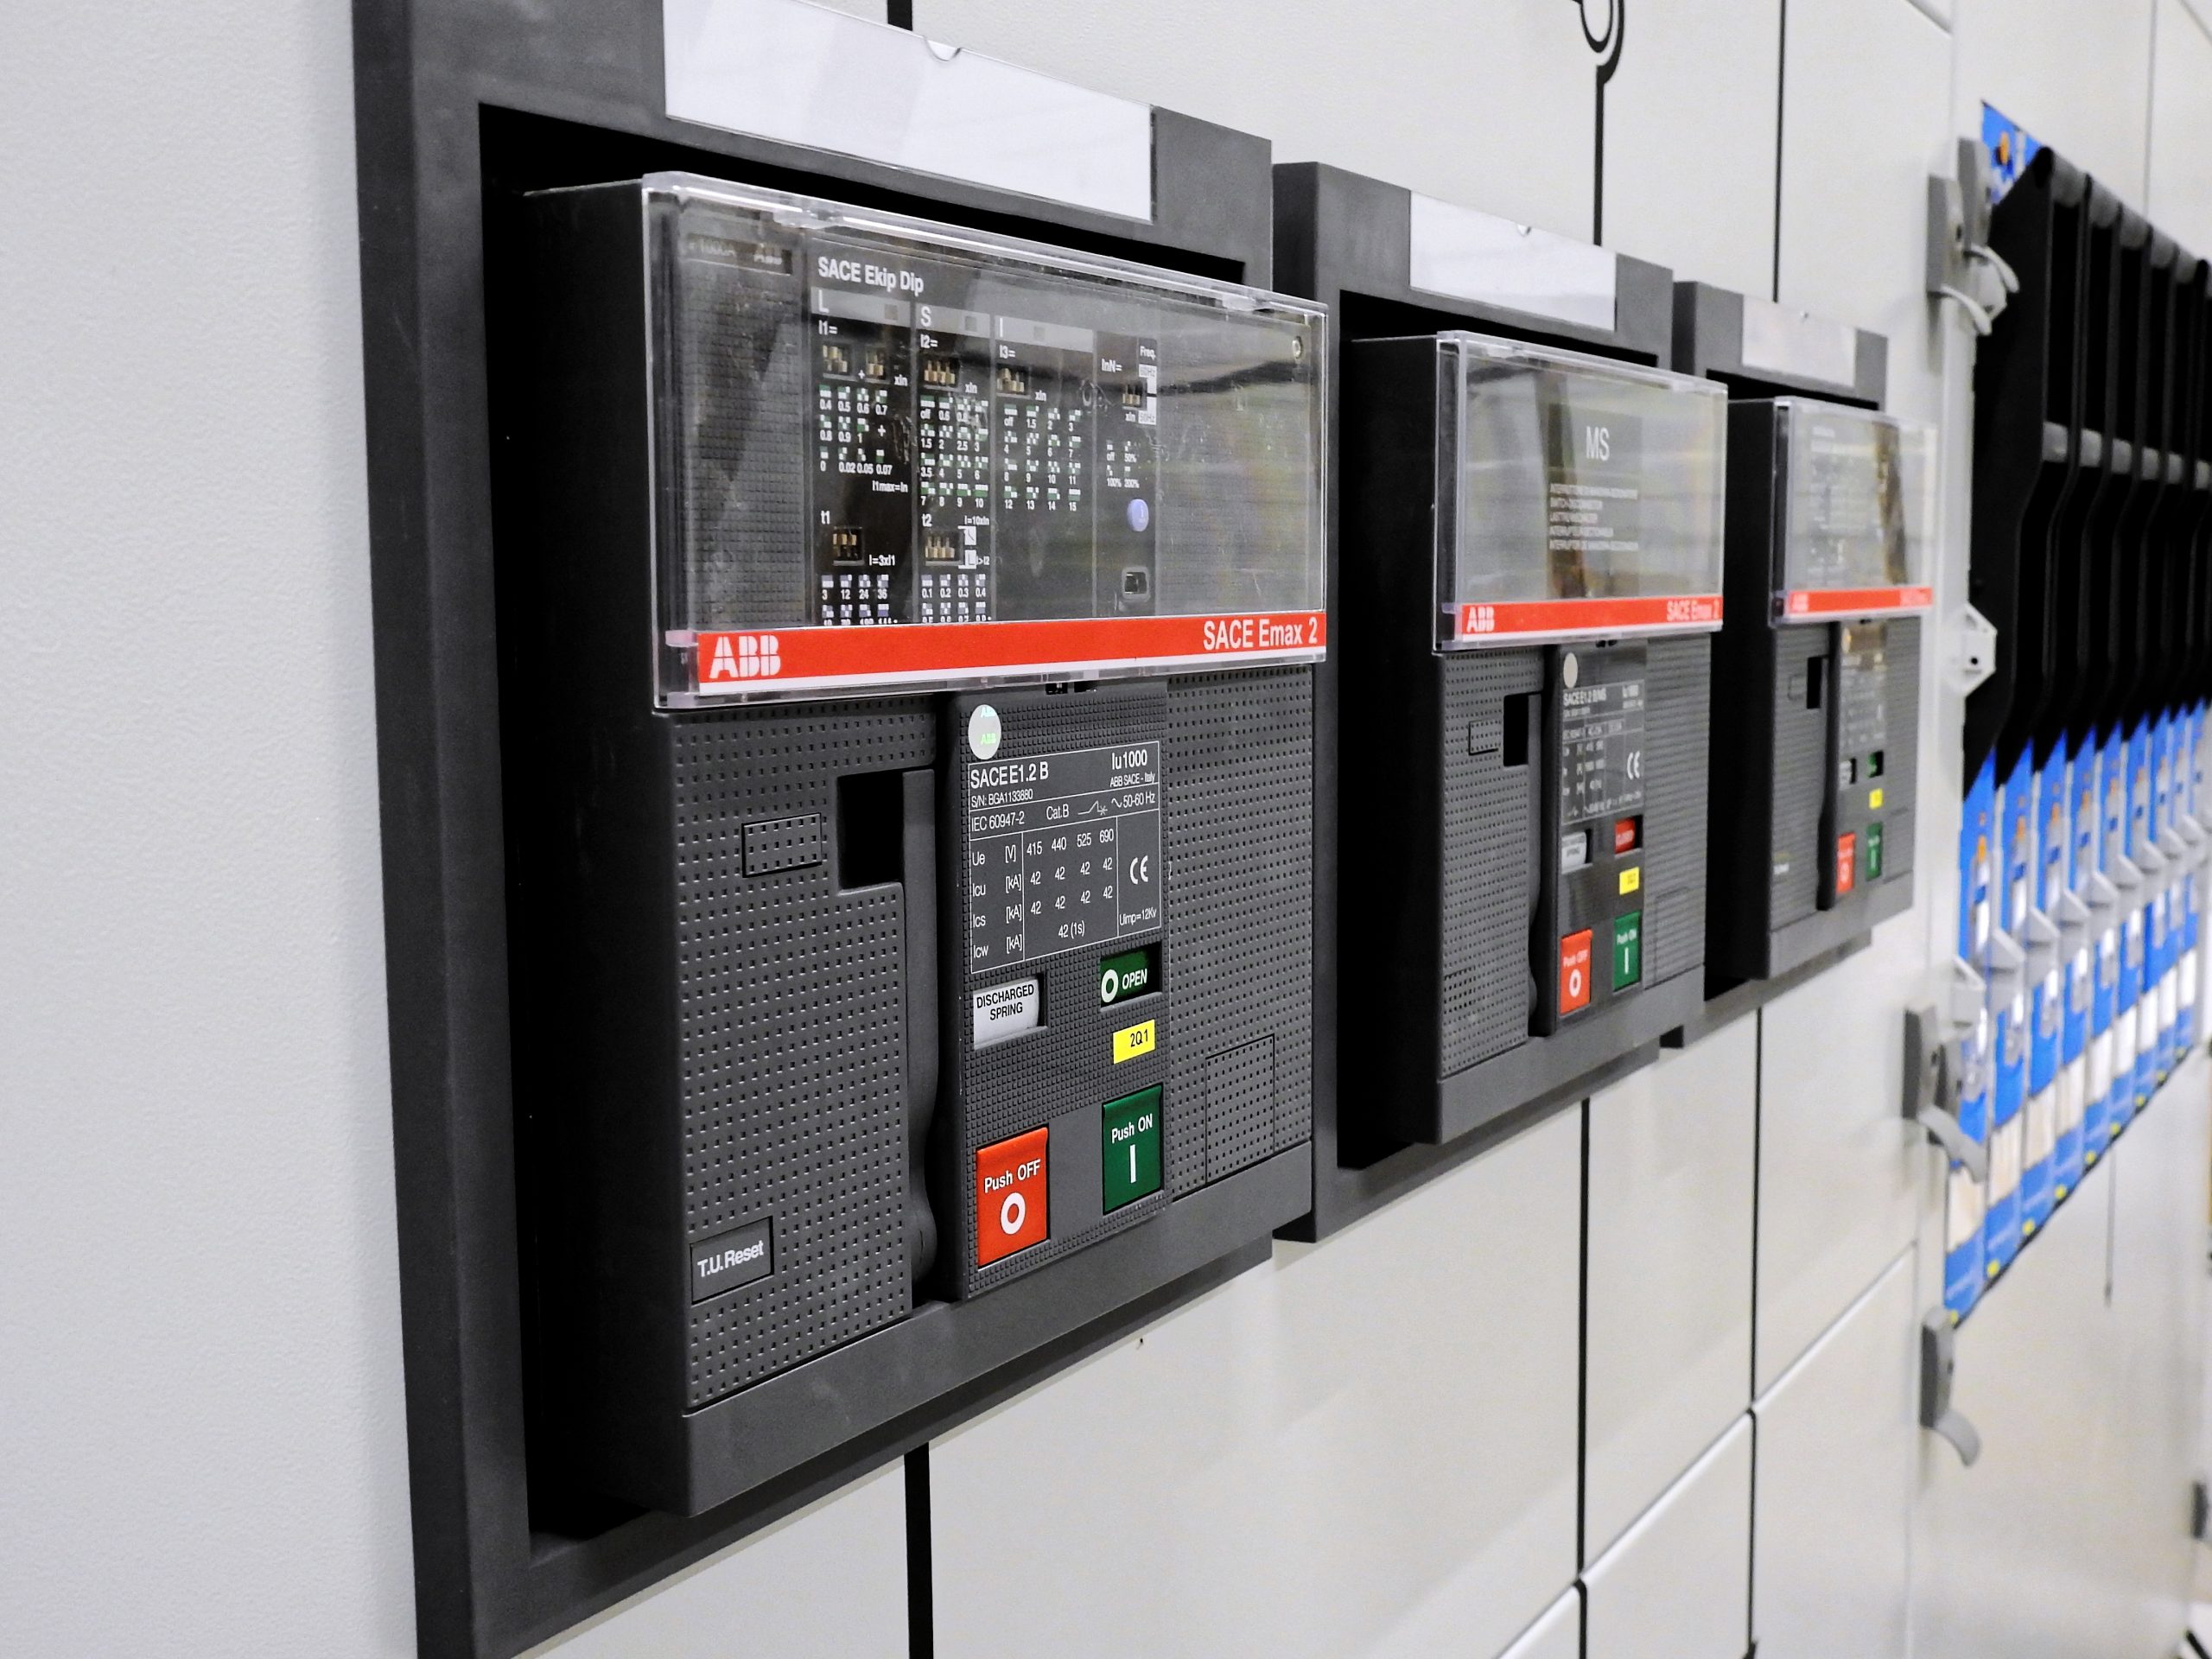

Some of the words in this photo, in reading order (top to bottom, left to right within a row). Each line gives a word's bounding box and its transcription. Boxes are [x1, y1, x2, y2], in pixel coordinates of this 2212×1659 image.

[817, 256, 861, 283] SACE
[864, 264, 896, 292] Ekip
[899, 270, 924, 296] Dip
[818, 289, 830, 314] L
[920, 305, 931, 327] S
[820, 398, 832, 410] 0.4
[838, 400, 851, 412] 0.5
[857, 402, 869, 415] 0.6
[875, 404, 888, 416] 0.7
[938, 410, 950, 422] 0.6
[1026, 418, 1037, 429] 1.5
[1047, 420, 1053, 430] 2
[1068, 422, 1074, 432] 3
[820, 429, 833, 442] 0.8
[838, 430, 851, 442] 0.9
[857, 432, 862, 443] 1
[920, 437, 932, 449] 1.5
[938, 438, 944, 450] 2
[957, 440, 969, 452] 2.5
[975, 441, 980, 453] 3
[1586, 426, 1610, 461] MS
[1004, 443, 1009, 454] 4
[1026, 445, 1032, 456] 5
[1047, 447, 1052, 457] 6
[1068, 448, 1074, 459] 7
[820, 460, 827, 472] 0
[838, 461, 856, 474] 0.02
[856, 462, 874, 474] 0.05
[875, 463, 893, 475] 0.07
[920, 466, 933, 479] 3.5
[938, 467, 944, 479] 4
[957, 468, 963, 480] 5
[975, 469, 981, 480] 6
[1004, 471, 1009, 482] 8
[1026, 473, 1032, 483] 9
[1047, 474, 1056, 485] 10
[1068, 474, 1077, 486] 11
[920, 495, 926, 506] 7
[938, 496, 945, 507] 8
[957, 497, 963, 508] 9
[975, 497, 984, 508] 10
[1004, 499, 1014, 510] 12
[1026, 499, 1035, 511] 13
[1047, 500, 1056, 512] 14
[1068, 501, 1077, 512] 15
[921, 512, 932, 527] t2
[822, 588, 828, 601] 3
[840, 588, 851, 601] 12
[858, 588, 869, 600] 24
[877, 588, 887, 600] 36
[921, 588, 933, 599] 0.1
[939, 588, 951, 598] 0.2
[957, 587, 969, 598] 0.3
[1466, 606, 1495, 632] ABB
[1203, 619, 1254, 651] SACE
[1258, 618, 1303, 647] Emax
[1308, 616, 1318, 644] 2
[709, 634, 781, 679] ABB
[970, 766, 1007, 789] SACE
[1009, 763, 1037, 784] E1.2
[1039, 761, 1049, 780] B
[1109, 776, 1122, 788] ABB
[1123, 772, 1141, 787] SACE
[971, 816, 988, 832] IEC
[988, 810, 1025, 830] 60947-2
[972, 851, 985, 867] Ue
[1027, 841, 1043, 856] 415
[1051, 836, 1067, 851] 440
[1077, 832, 1092, 848] 525
[1099, 828, 1115, 843] 690
[1030, 870, 1041, 886] 42
[1054, 866, 1065, 880] 42
[1080, 861, 1090, 875] 42
[1103, 856, 1113, 871] 42
[1030, 900, 1042, 915] 42
[1055, 895, 1065, 910] 42
[1080, 890, 1090, 904] 42
[1103, 885, 1113, 899] 42
[1058, 924, 1069, 938] 42
[1122, 968, 1147, 990] OPEN
[976, 983, 1034, 1008] DISCHARGED
[989, 1001, 1023, 1020] SPRING
[1111, 1122, 1135, 1144] Push
[1138, 1113, 1154, 1133] ON
[983, 1170, 1014, 1193] Push
[1017, 1159, 1041, 1181] OFF
